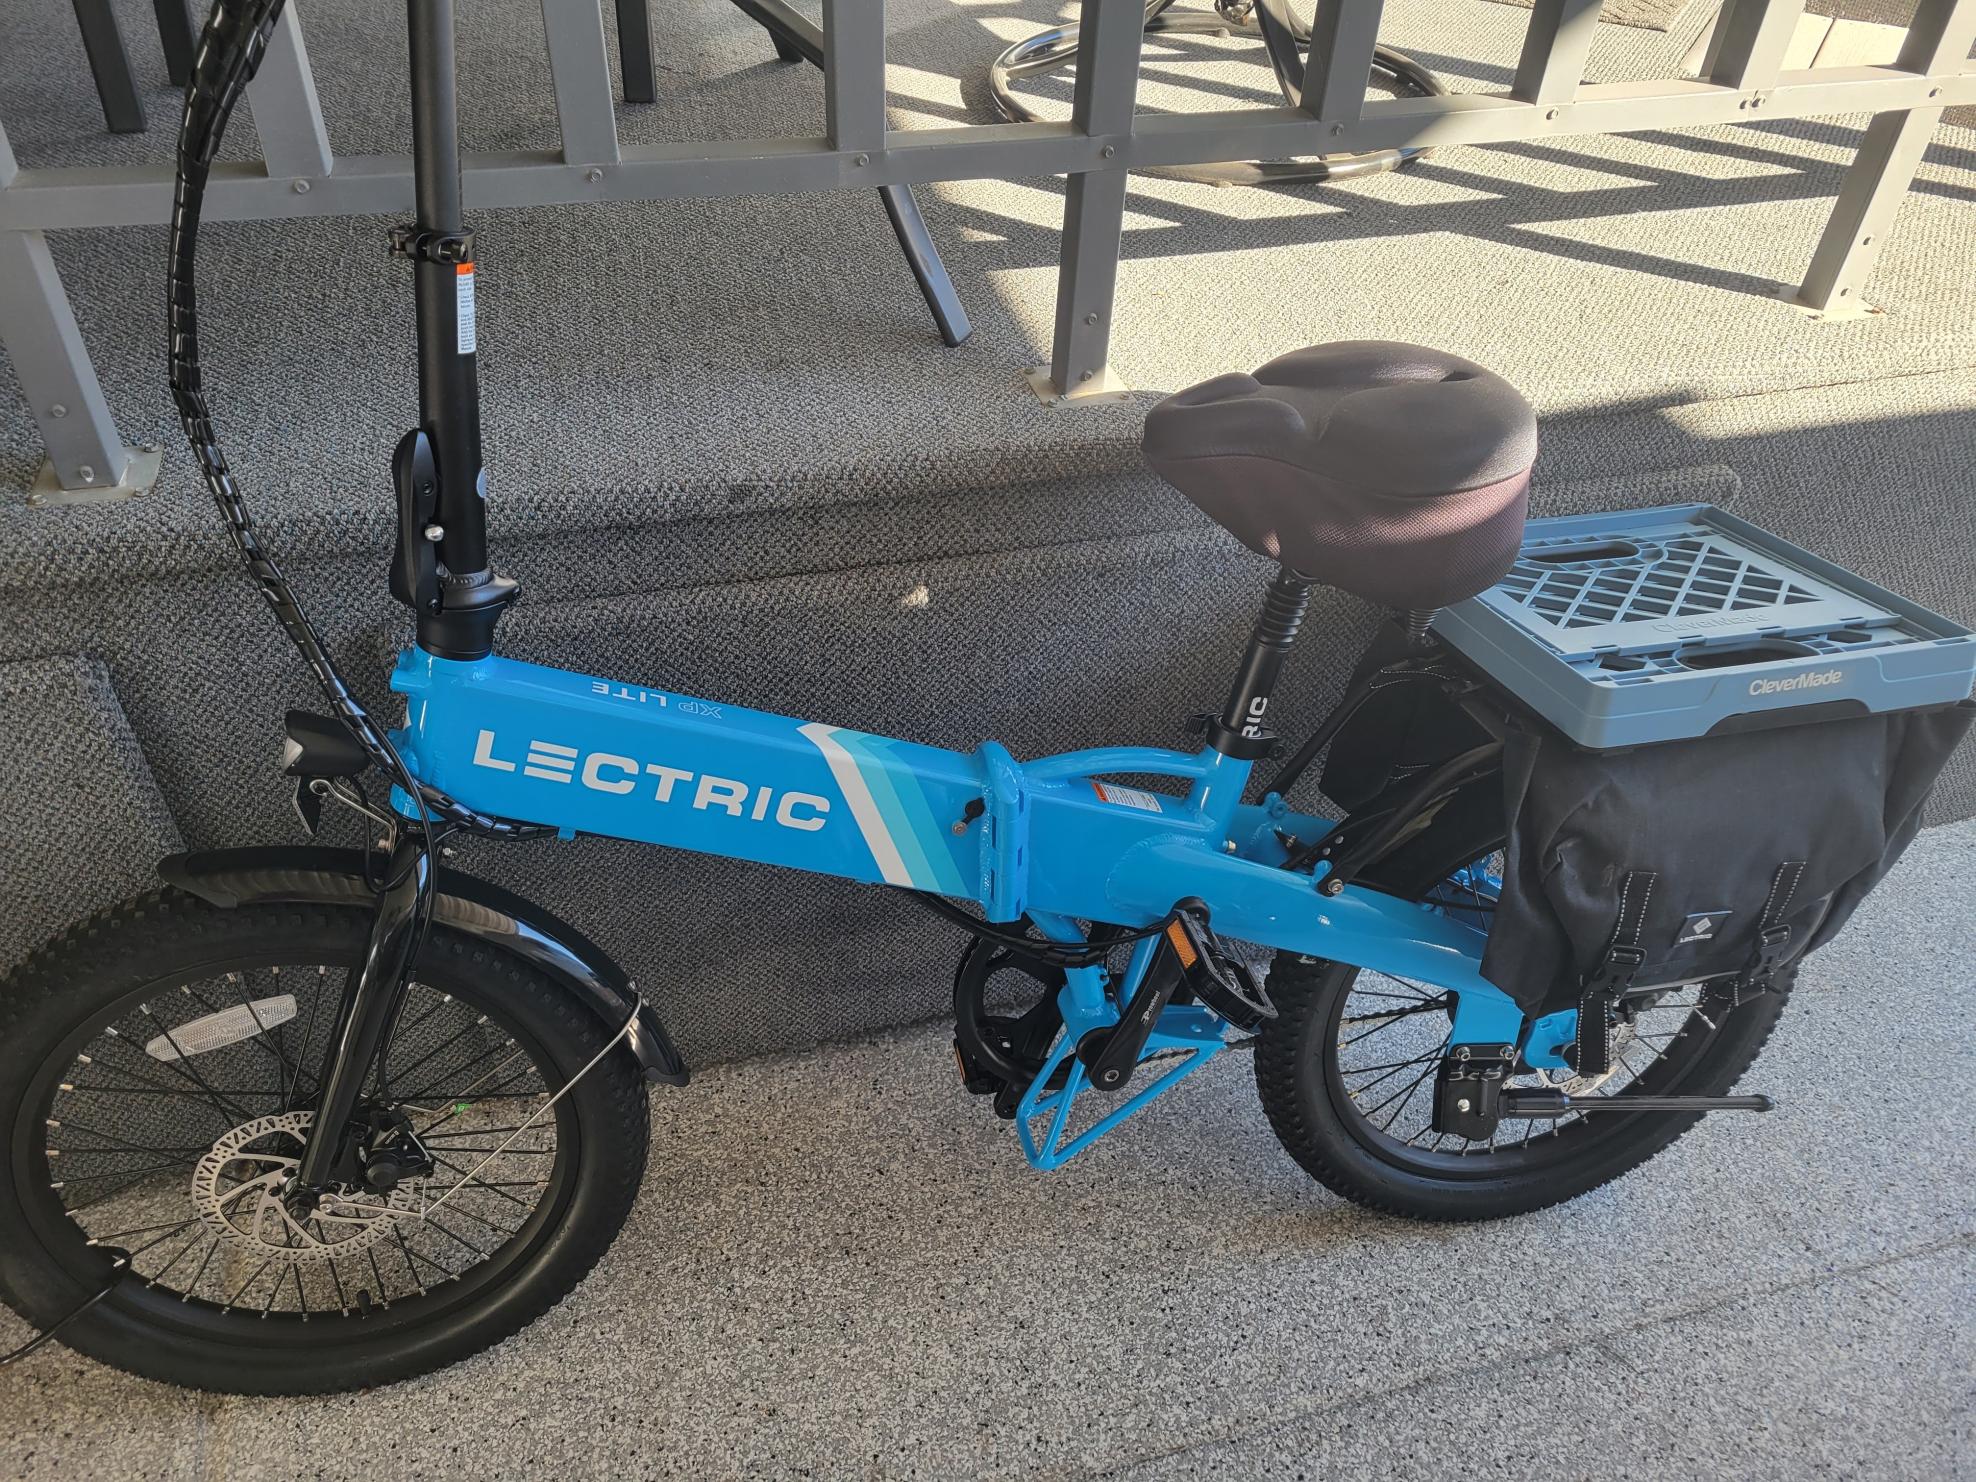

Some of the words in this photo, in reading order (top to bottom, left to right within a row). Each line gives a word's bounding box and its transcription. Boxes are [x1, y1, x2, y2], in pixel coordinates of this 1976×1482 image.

[591, 681, 667, 707] LITE
[1749, 669, 1842, 695] CleverMade
[678, 702, 722, 719] XP
[472, 729, 831, 832] LECTRIC
